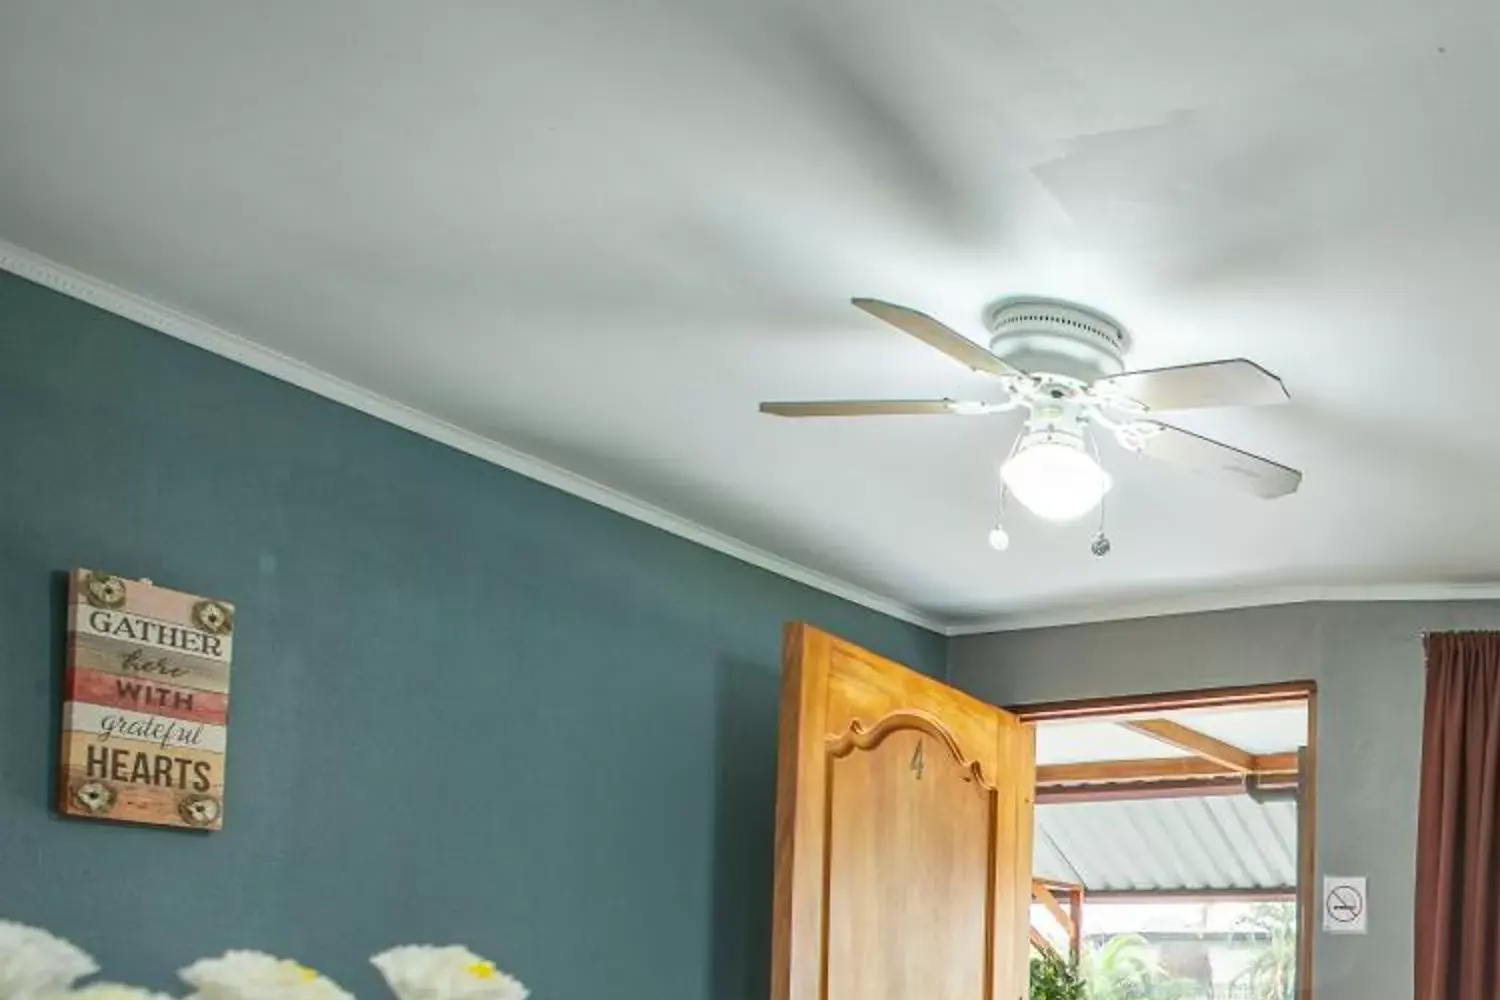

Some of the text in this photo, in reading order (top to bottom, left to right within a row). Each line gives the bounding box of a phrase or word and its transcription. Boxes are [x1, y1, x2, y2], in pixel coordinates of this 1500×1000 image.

[90, 610, 222, 656] GATHER
[121, 648, 189, 679] here
[116, 679, 194, 711] WITH
[101, 714, 205, 750] grateful
[86, 745, 211, 792] HEARTS
[910, 737, 924, 780] 4
